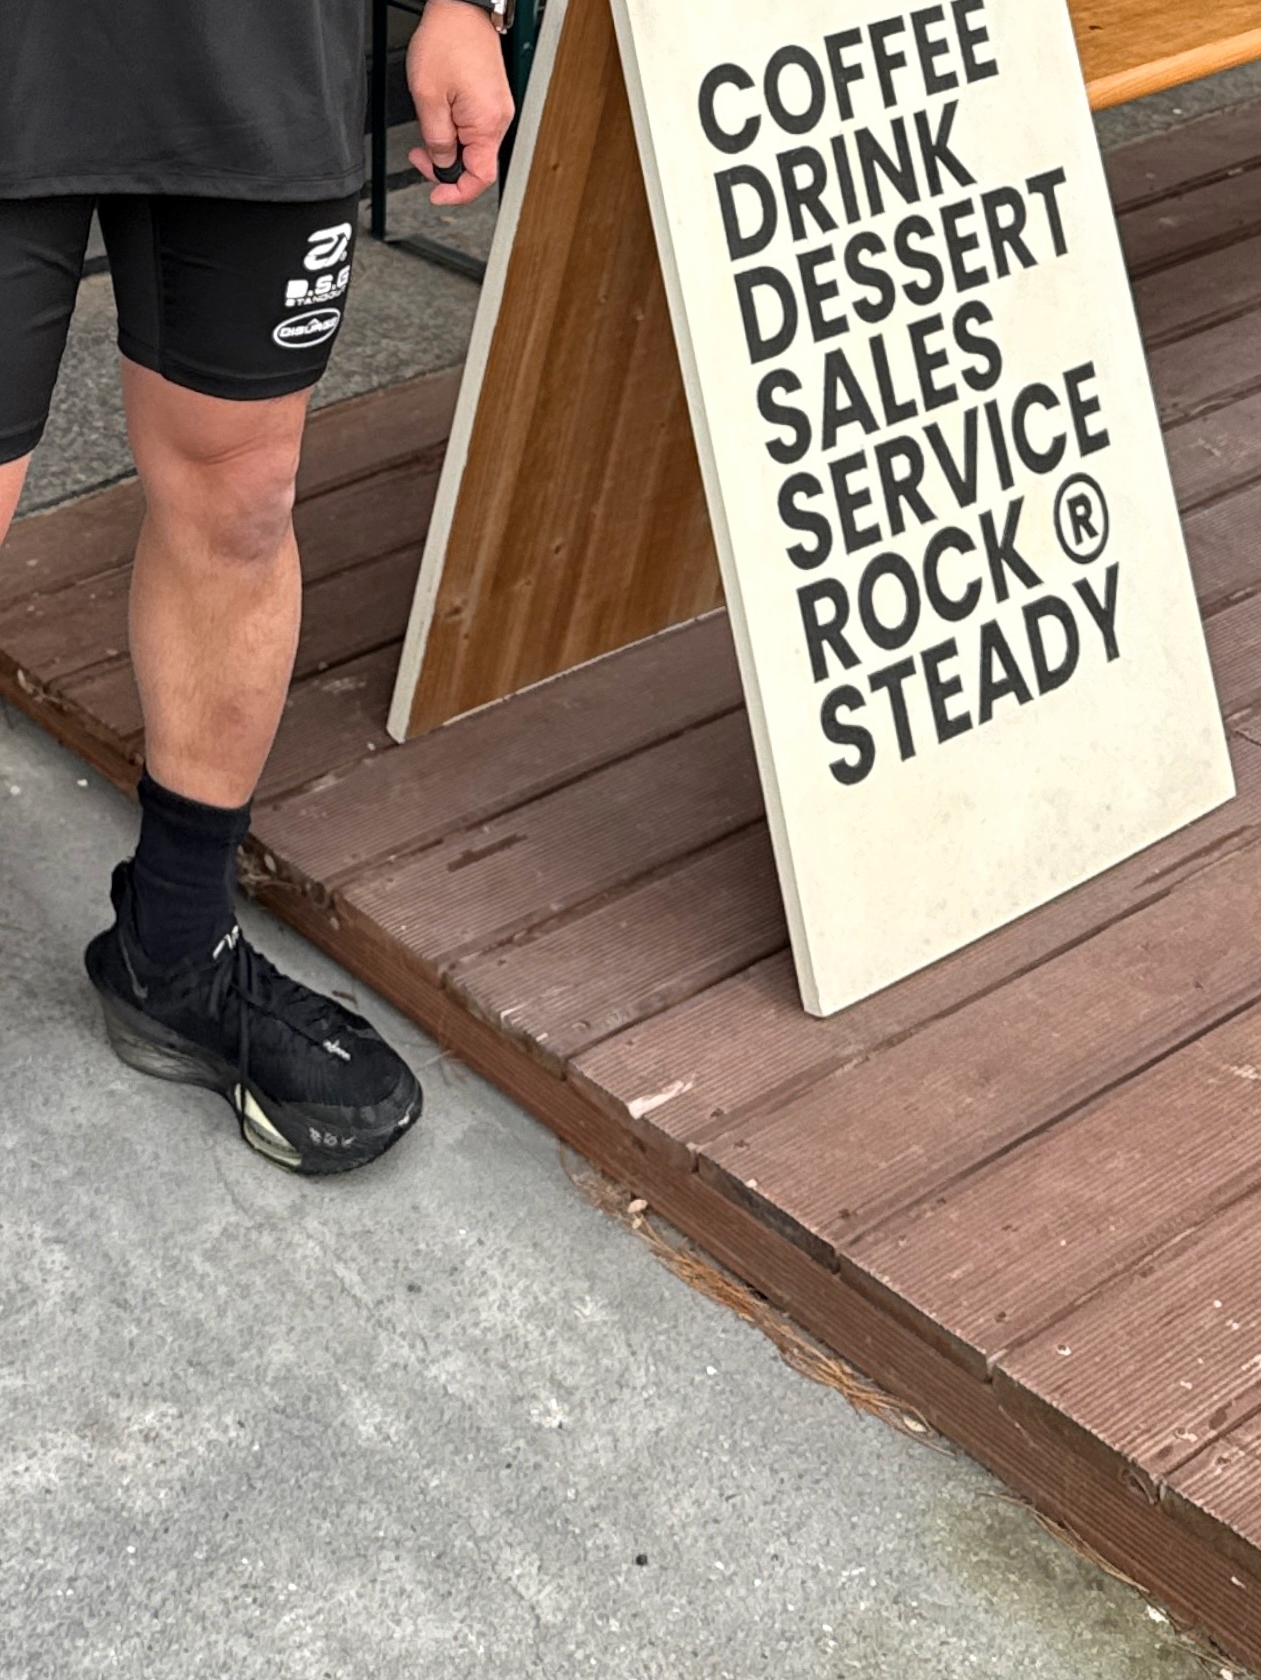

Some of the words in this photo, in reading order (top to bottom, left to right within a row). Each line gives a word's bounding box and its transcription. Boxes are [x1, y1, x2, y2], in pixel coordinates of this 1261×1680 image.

[713, 99, 977, 262] DRINK
[733, 167, 1068, 365] DESSERT
[756, 300, 1002, 465] SALES
[777, 361, 1110, 571] SERVICE
[796, 496, 1043, 683] ROCK
[820, 562, 1120, 786] STEADY
